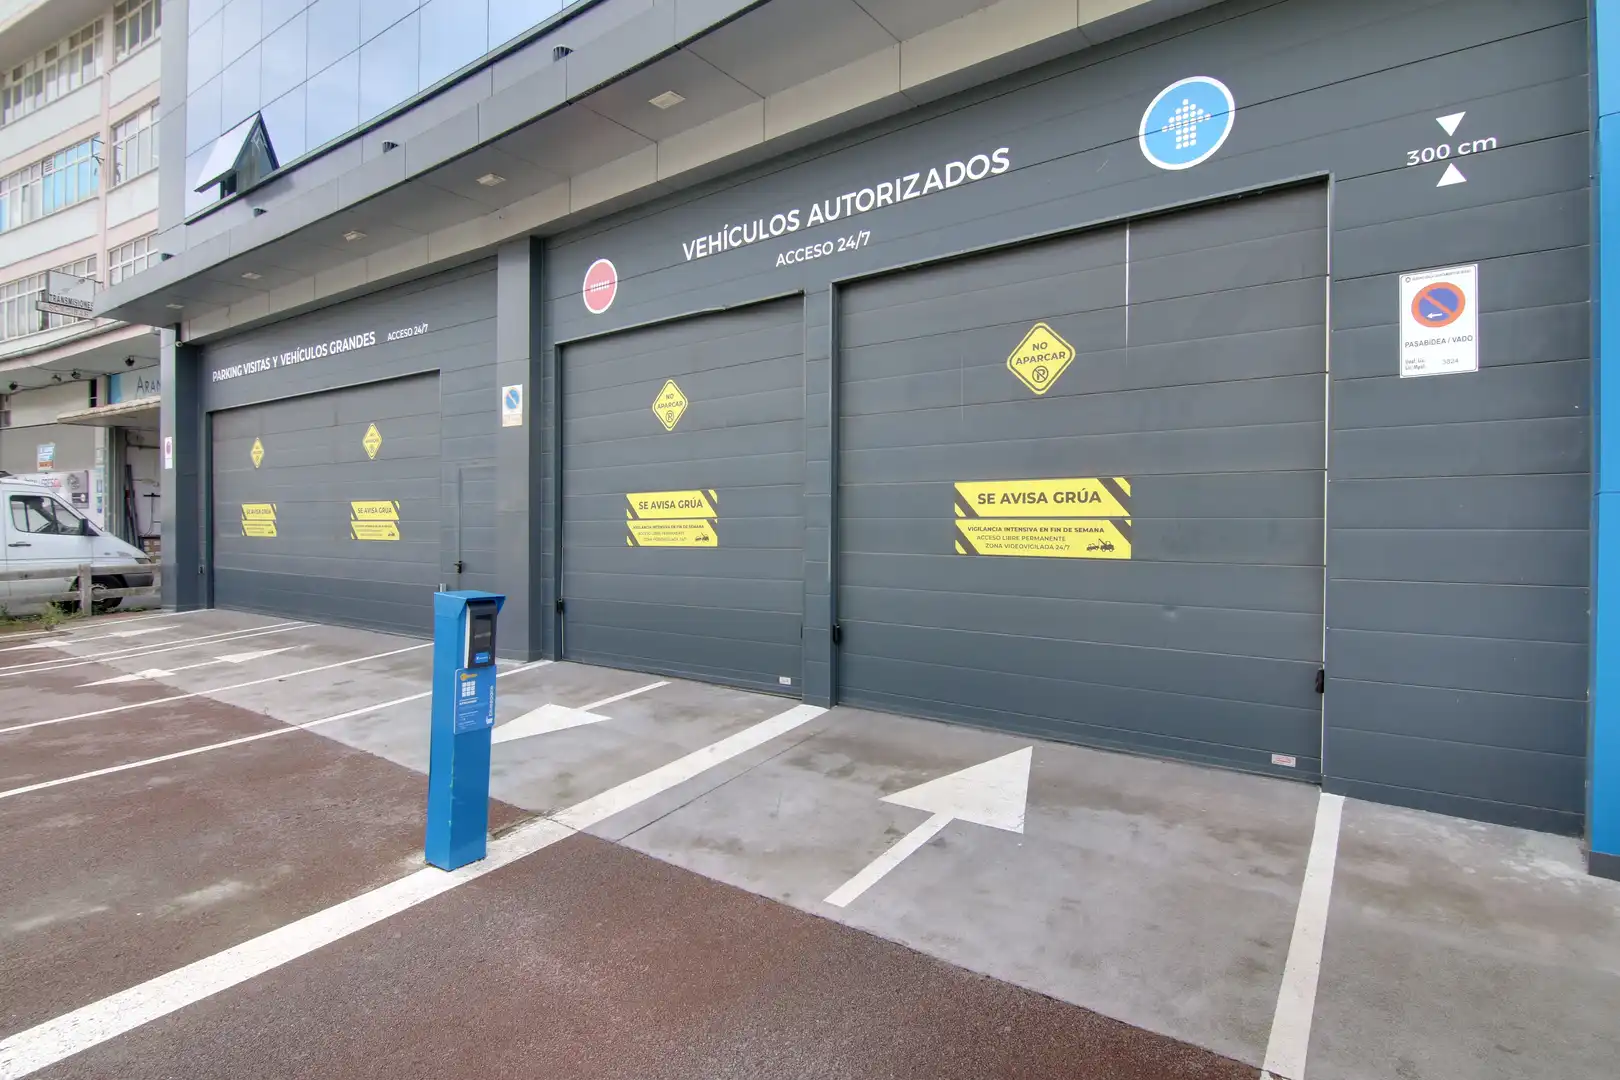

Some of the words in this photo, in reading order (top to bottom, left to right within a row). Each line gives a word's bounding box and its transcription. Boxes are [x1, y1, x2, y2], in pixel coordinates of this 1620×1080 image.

[1406, 145, 1450, 166] 300
[1457, 137, 1497, 156] cm
[683, 209, 800, 262] VEHÍCULOS
[806, 147, 1010, 227] AUTORIZADOS
[775, 242, 834, 268] ACCESO
[837, 231, 871, 252] 24/7
[387, 329, 413, 342] ACCESO
[413, 321, 429, 336] 24/7
[1452, 335, 1473, 343] VADO
[1032, 341, 1048, 351] NO
[212, 363, 243, 382] PARKING
[243, 357, 271, 376] VISITAS
[272, 356, 279, 368] Y
[280, 343, 328, 366] VEHÍCULOS
[329, 331, 376, 355] GRANDES
[1015, 351, 1066, 366] APARCAR
[658, 401, 683, 409] APARCAR
[639, 501, 649, 510] SE
[650, 500, 676, 510] AVISA
[678, 497, 703, 508] GRÚA
[977, 493, 996, 504] SE
[999, 492, 1049, 504] AVISA
[1052, 488, 1102, 503] GRÚA
